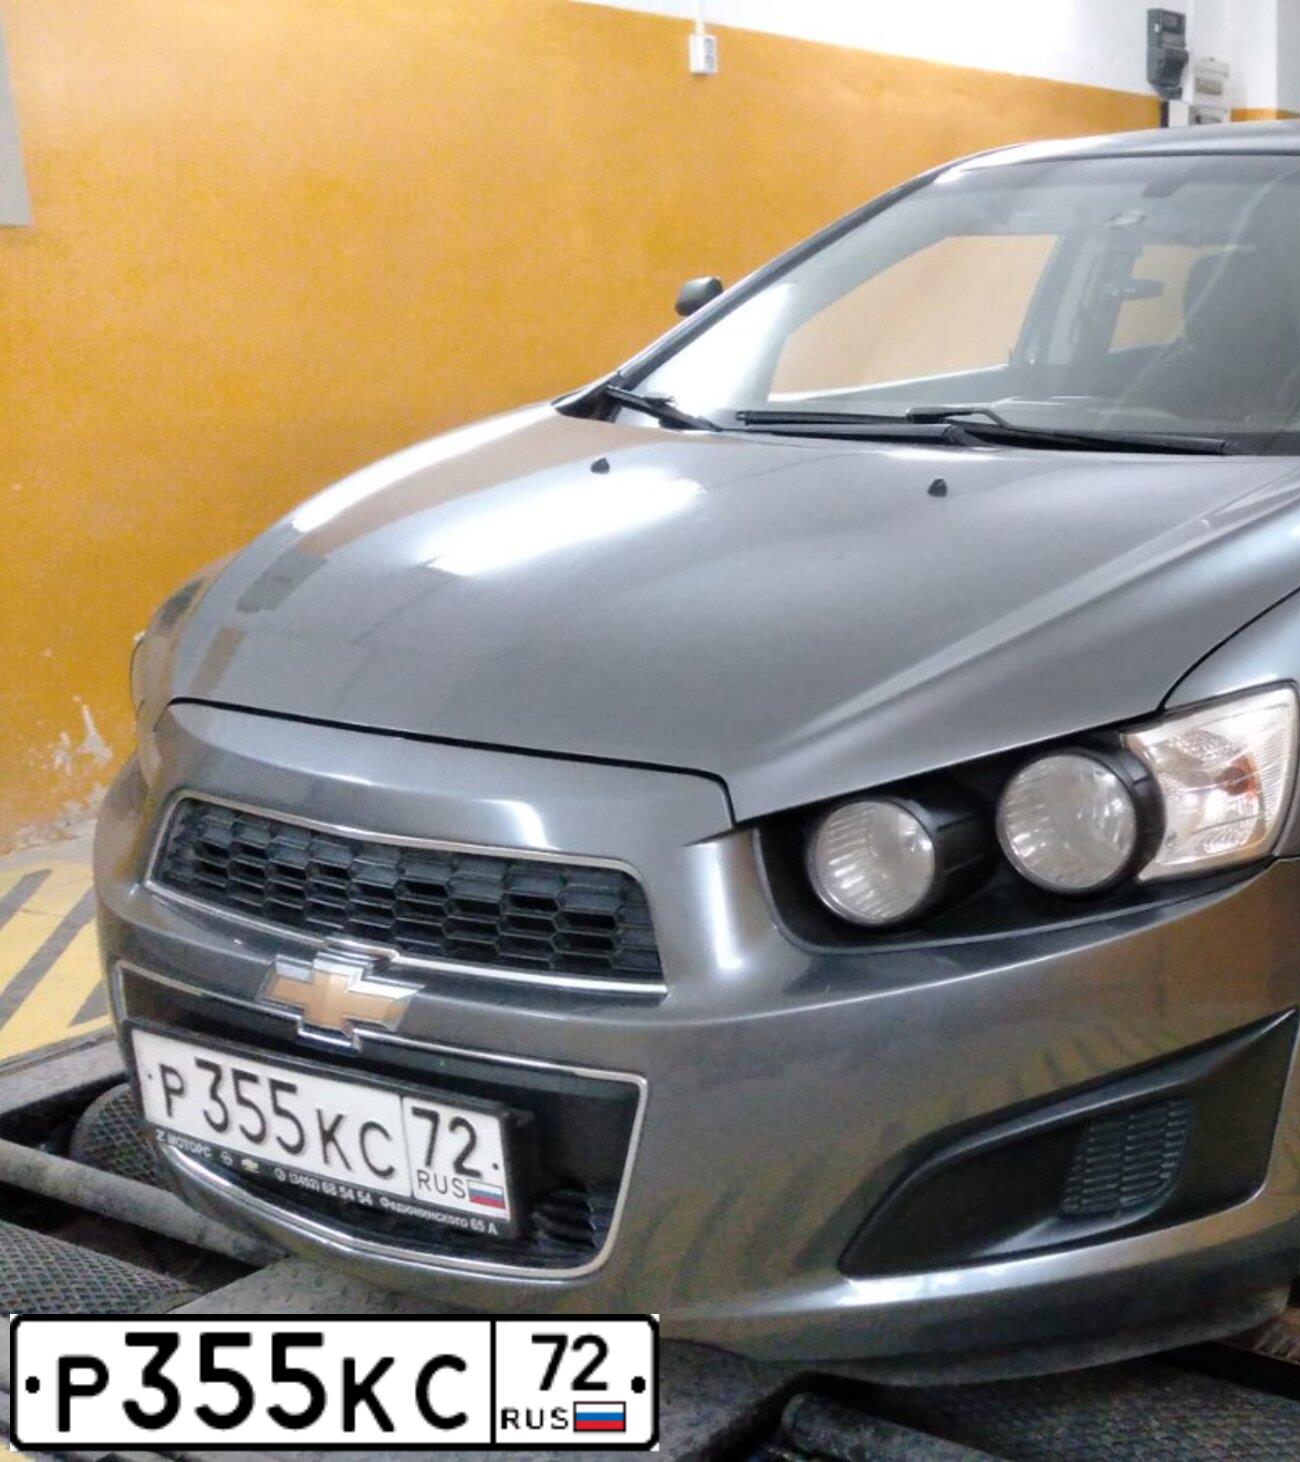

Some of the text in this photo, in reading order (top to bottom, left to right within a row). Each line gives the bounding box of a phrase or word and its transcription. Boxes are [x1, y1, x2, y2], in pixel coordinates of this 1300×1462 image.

[160, 1058, 481, 1178] Р355КС 72
[418, 1170, 466, 1198] RUS
